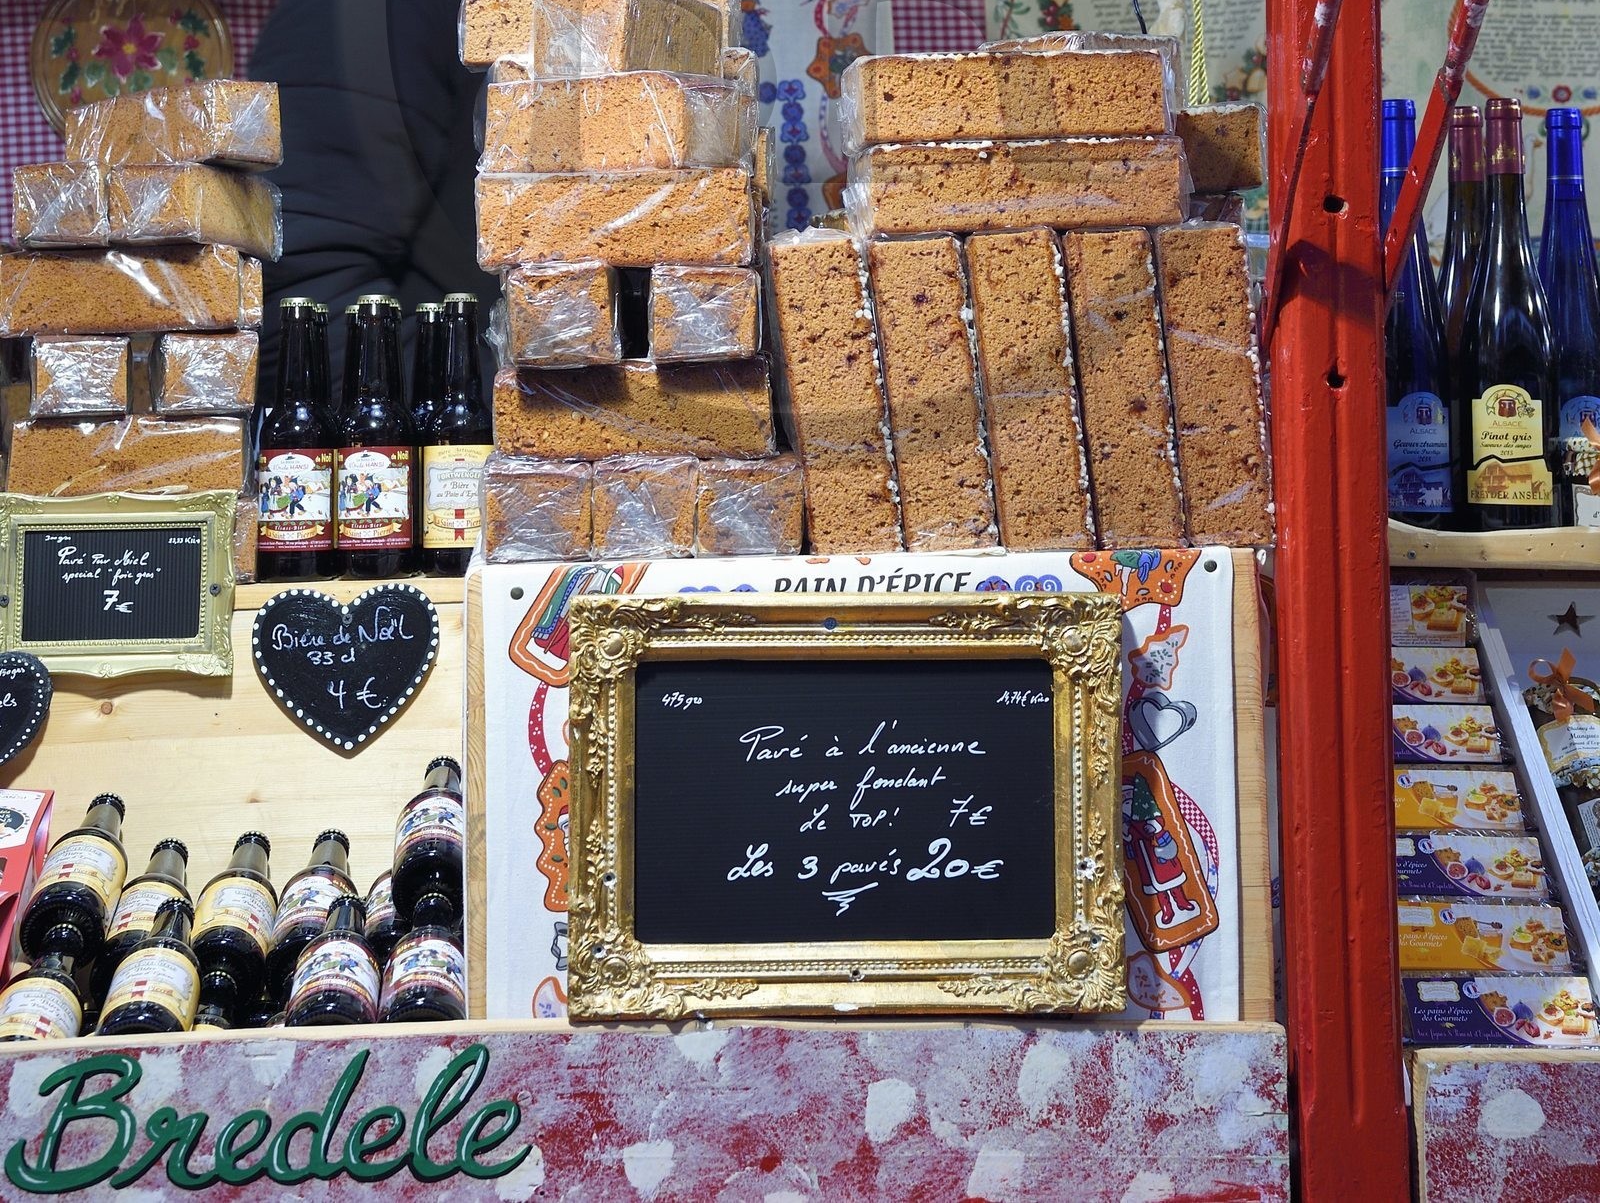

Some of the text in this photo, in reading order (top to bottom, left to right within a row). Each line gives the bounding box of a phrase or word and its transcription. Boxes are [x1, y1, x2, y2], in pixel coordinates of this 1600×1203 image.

[1493, 420, 1523, 428] ALSACE
[1481, 431, 1533, 443] Pinot gris
[450, 482, 469, 490] Bière
[440, 519, 455, 527] Saint
[271, 530, 286, 539] Saint
[348, 529, 362, 538] Saint
[58, 546, 84, 565] Pavé
[113, 549, 148, 566] Miel
[61, 567, 101, 584] special
[103, 589, 134, 614] 7€
[271, 606, 413, 651] Bière de Noël
[306, 651, 336, 665] 33
[327, 676, 382, 710] 4 €
[738, 719, 986, 762] Pavé à l'ancienne
[775, 766, 947, 810] super fondant
[799, 795, 993, 832] Le TOP! 7€
[727, 836, 1005, 885] Les 3 pavés 20€
[1414, 1006, 1426, 1015] Les
[1427, 1008, 1447, 1016] pains
[1434, 1014, 1468, 1022] Gourmets
[4, 1043, 534, 1194] Bredele
